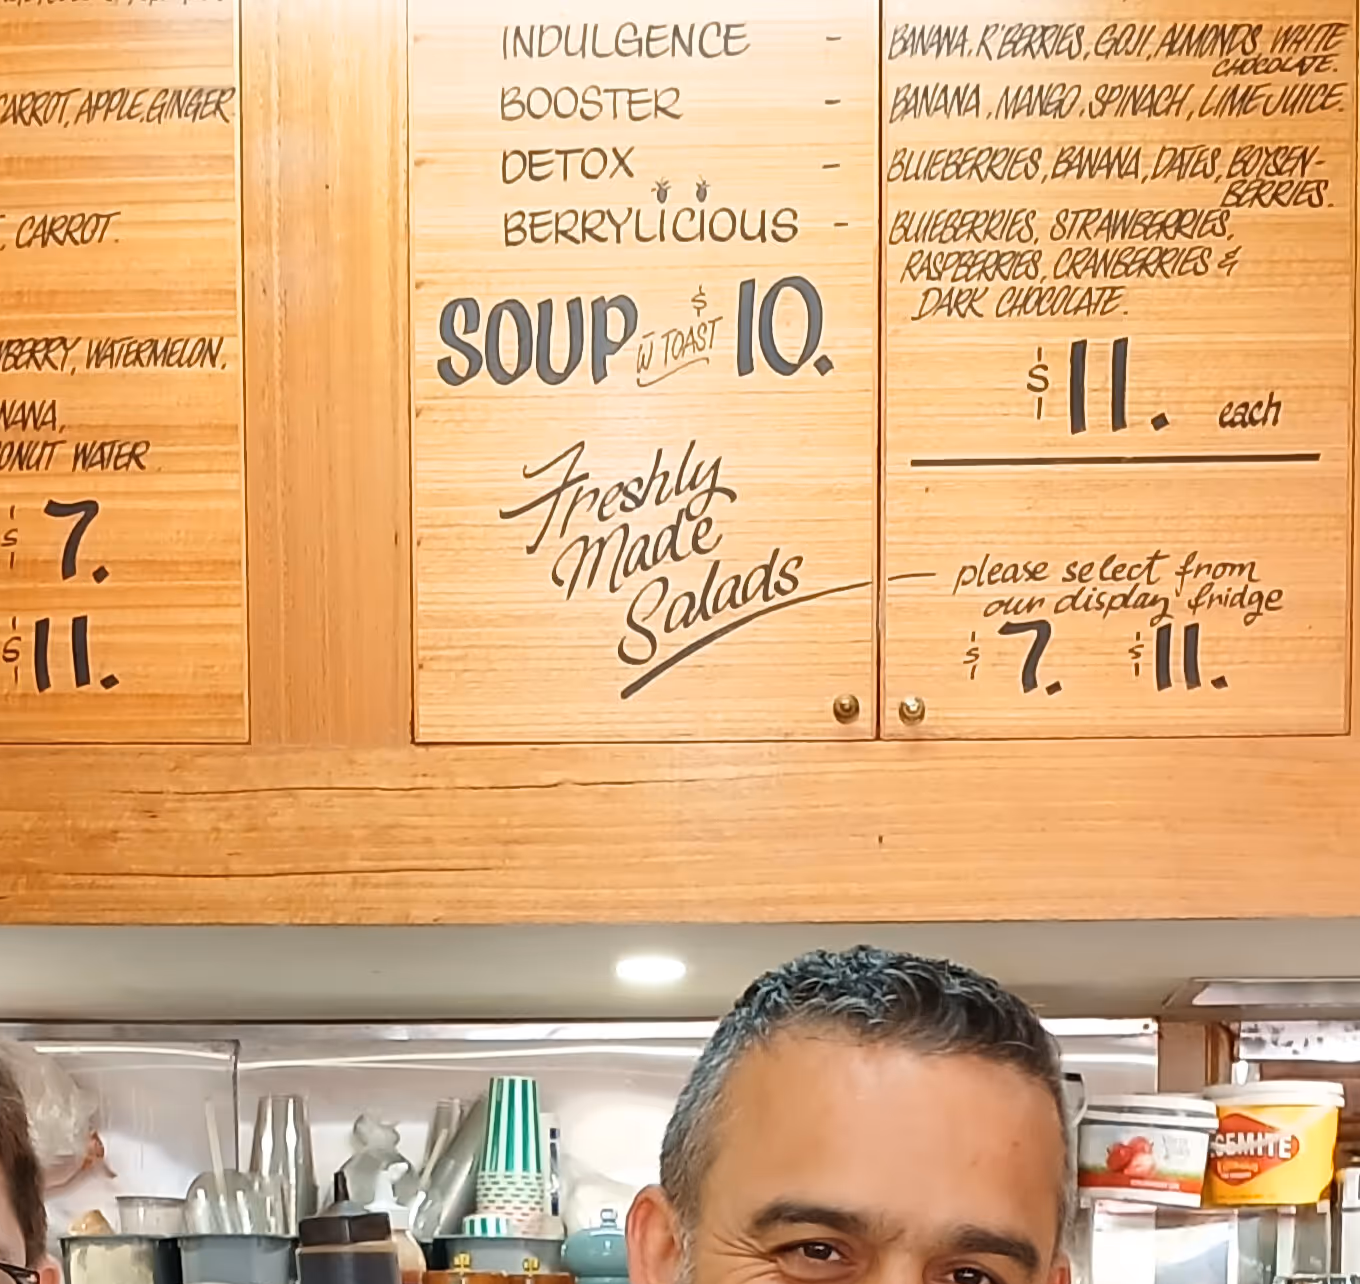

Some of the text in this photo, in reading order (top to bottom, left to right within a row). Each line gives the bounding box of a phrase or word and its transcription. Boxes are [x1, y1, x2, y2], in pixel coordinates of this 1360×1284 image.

[502, 21, 751, 61] INDULGENCE
[1271, 23, 1351, 55] WHITE
[500, 85, 684, 122] BOOSTER
[1088, 83, 1193, 122] SPINACH,
[1198, 83, 1270, 119] LIME
[501, 146, 635, 185] DETOX
[887, 147, 1048, 184] BLUEBERRIES,
[1050, 147, 1149, 183] BANANA,
[1152, 146, 1223, 183] DATES,
[503, 205, 799, 248] BERRYLICIOUS
[888, 208, 1235, 246] BLUEBERRIES, STRAWBERRIES,
[900, 249, 1047, 285] RASPBERRIES,
[1053, 246, 1211, 280] CRANBERRIES
[910, 287, 986, 322] DARK
[437, 294, 639, 386] SOUP
[661, 316, 724, 368] TOAST
[1218, 392, 1283, 429] each
[499, 440, 738, 555] Freshly
[551, 508, 723, 600] Made
[952, 549, 1261, 598] please select from
[617, 547, 804, 665] Salads
[983, 583, 1284, 626] our display fridge
